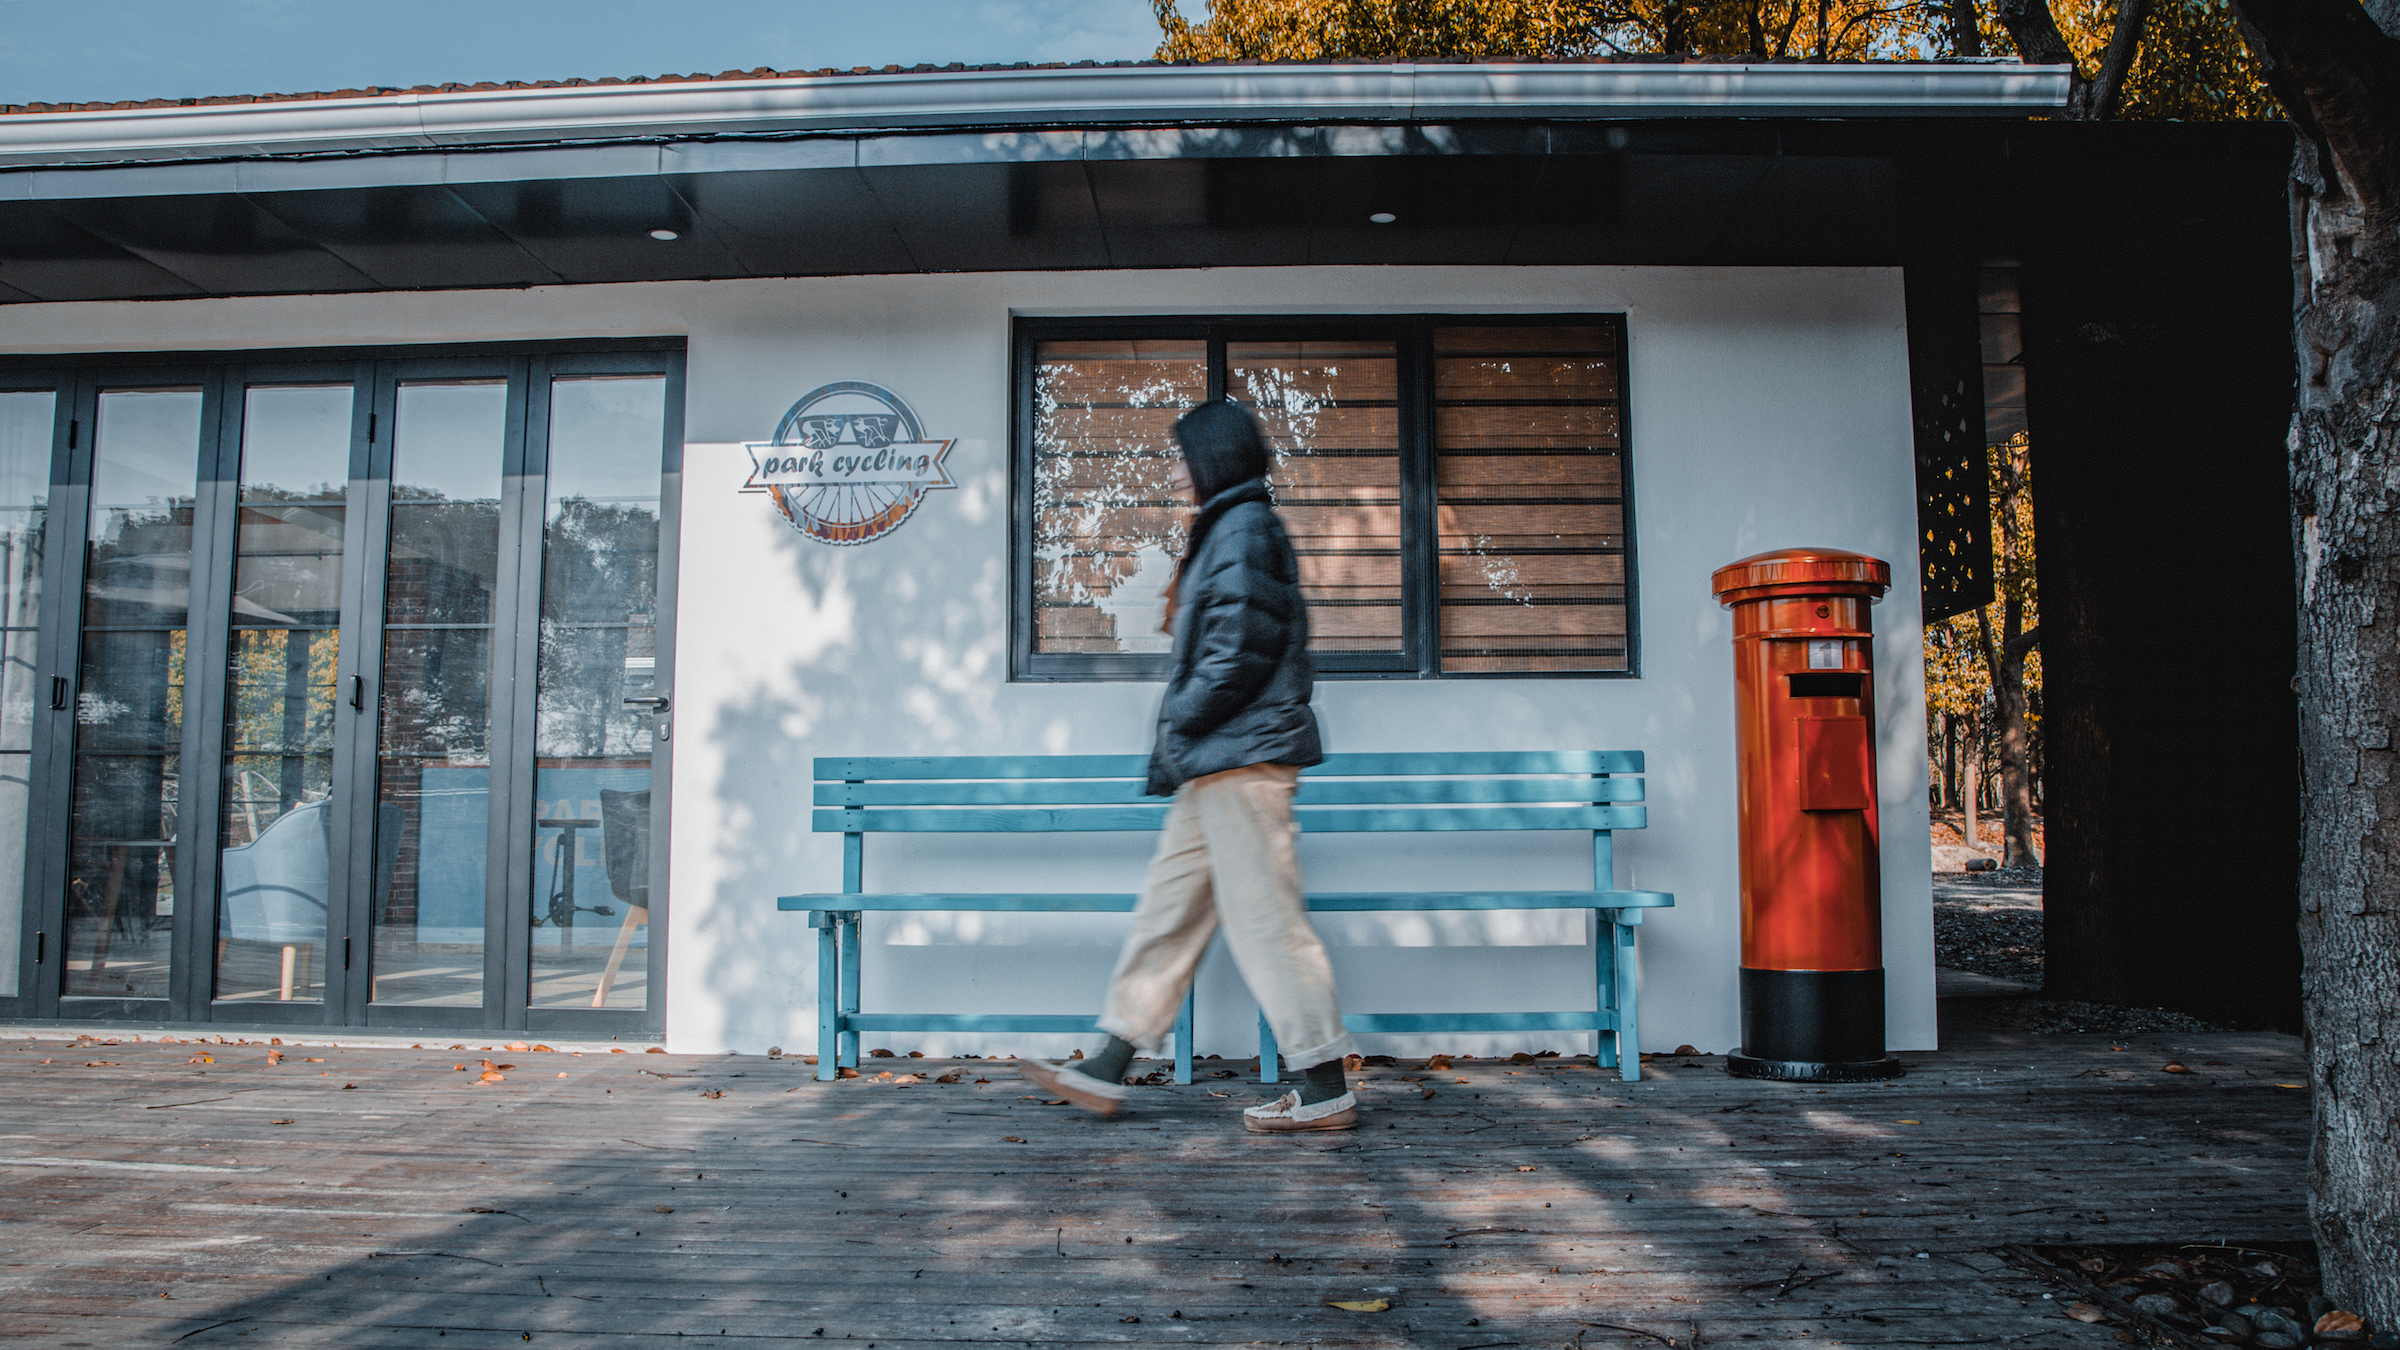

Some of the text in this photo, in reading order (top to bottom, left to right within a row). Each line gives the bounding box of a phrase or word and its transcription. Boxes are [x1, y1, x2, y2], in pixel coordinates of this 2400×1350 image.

[763, 449, 930, 479] park cycling
[1819, 642, 1832, 667] 1
